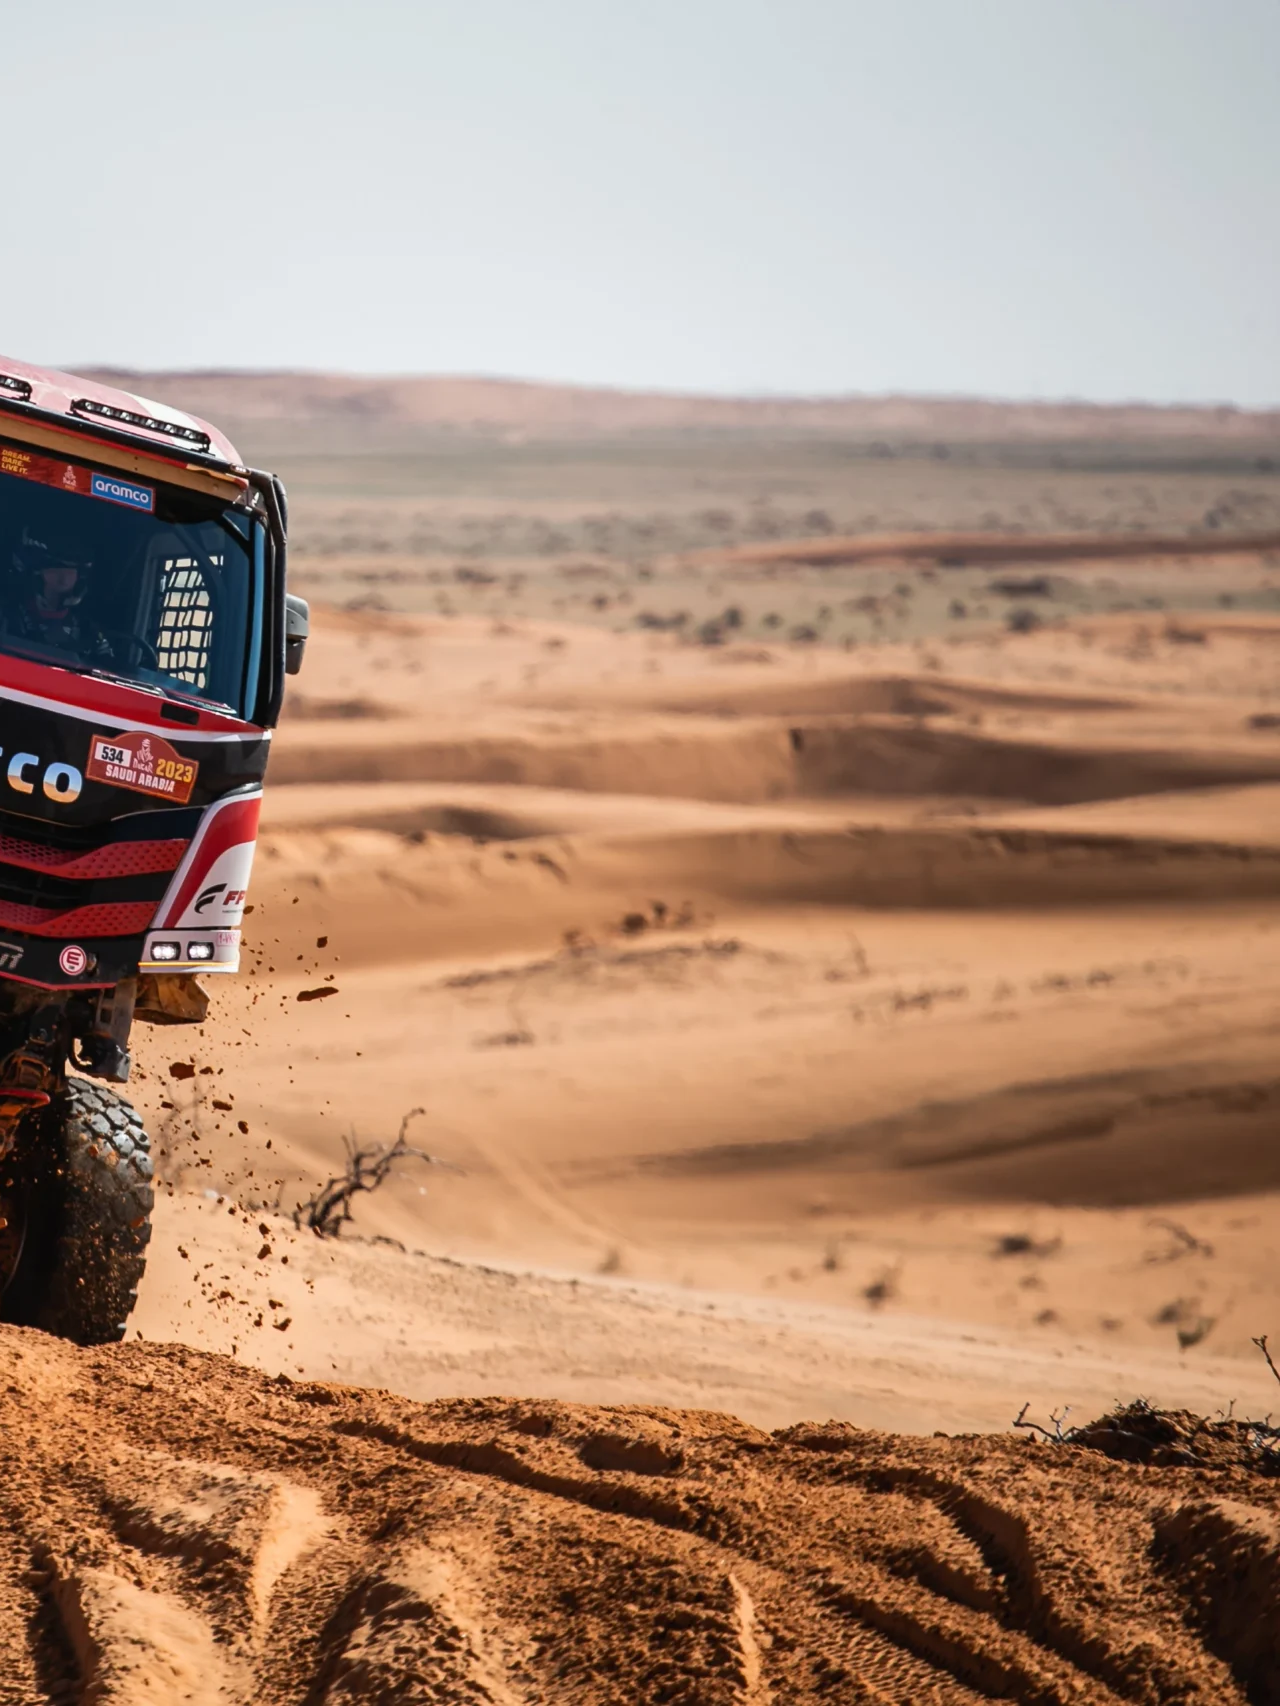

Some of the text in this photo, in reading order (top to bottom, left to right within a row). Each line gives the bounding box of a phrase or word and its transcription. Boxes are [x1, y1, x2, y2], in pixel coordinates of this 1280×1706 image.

[1, 462, 18, 473] LIVE
[95, 479, 149, 504] aramco
[101, 745, 124, 764] 534
[156, 758, 193, 783] 2023
[105, 764, 176, 793] SAUDI ARABIA
